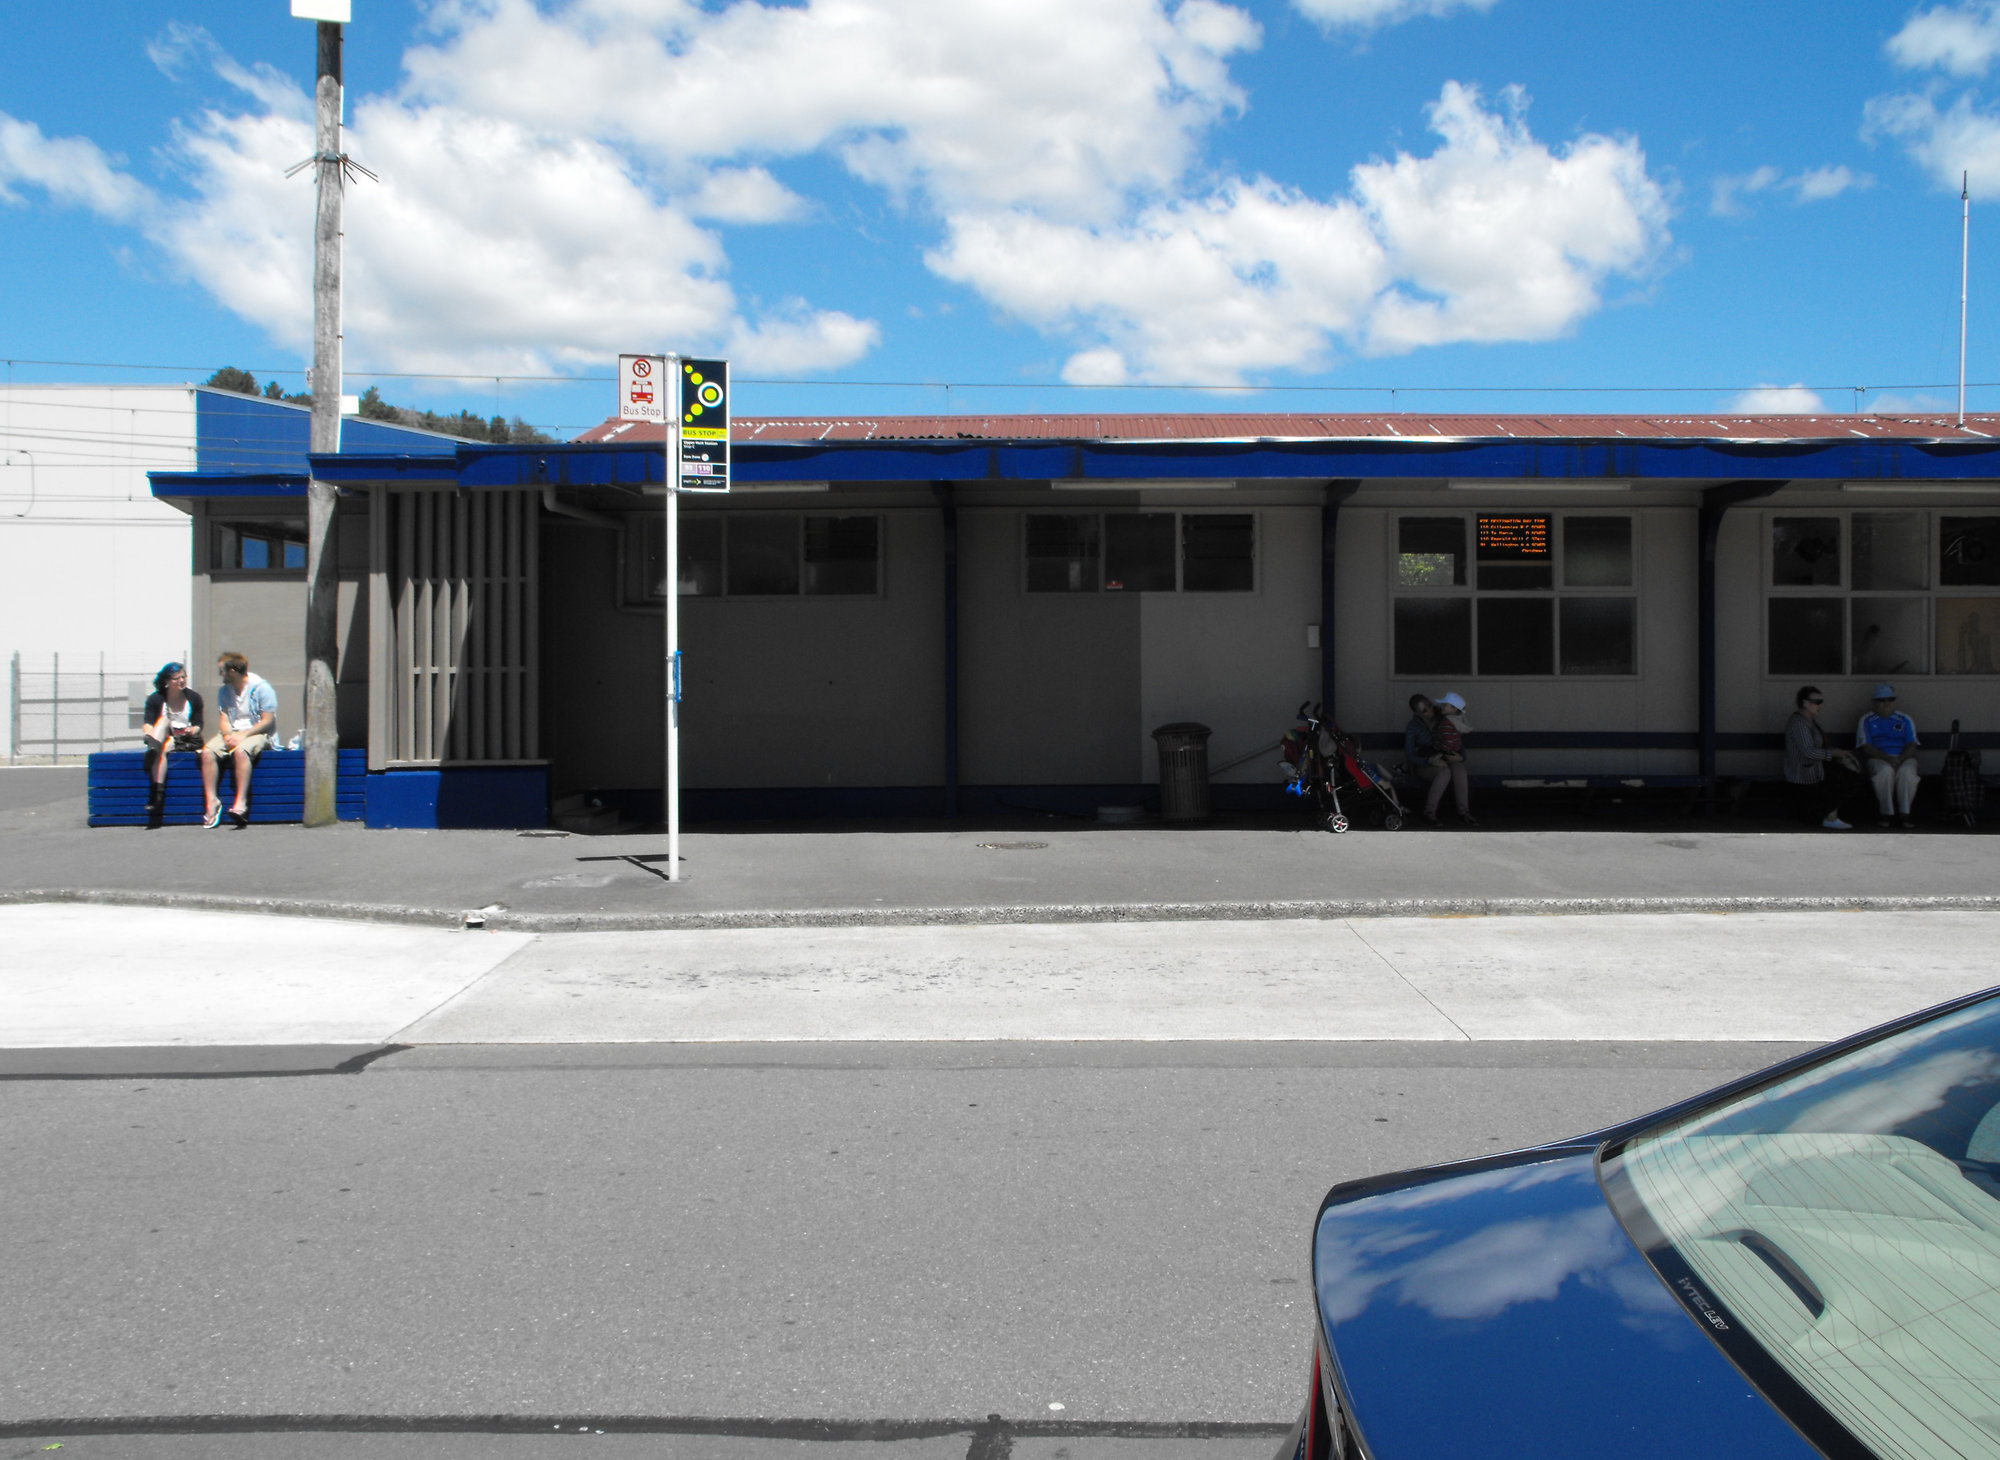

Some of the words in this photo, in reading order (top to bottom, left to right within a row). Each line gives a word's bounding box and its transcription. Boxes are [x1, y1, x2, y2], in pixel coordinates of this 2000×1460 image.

[623, 405, 639, 416] Bus
[641, 406, 661, 418] Stop
[1703, 1310, 1729, 1330] LEV
